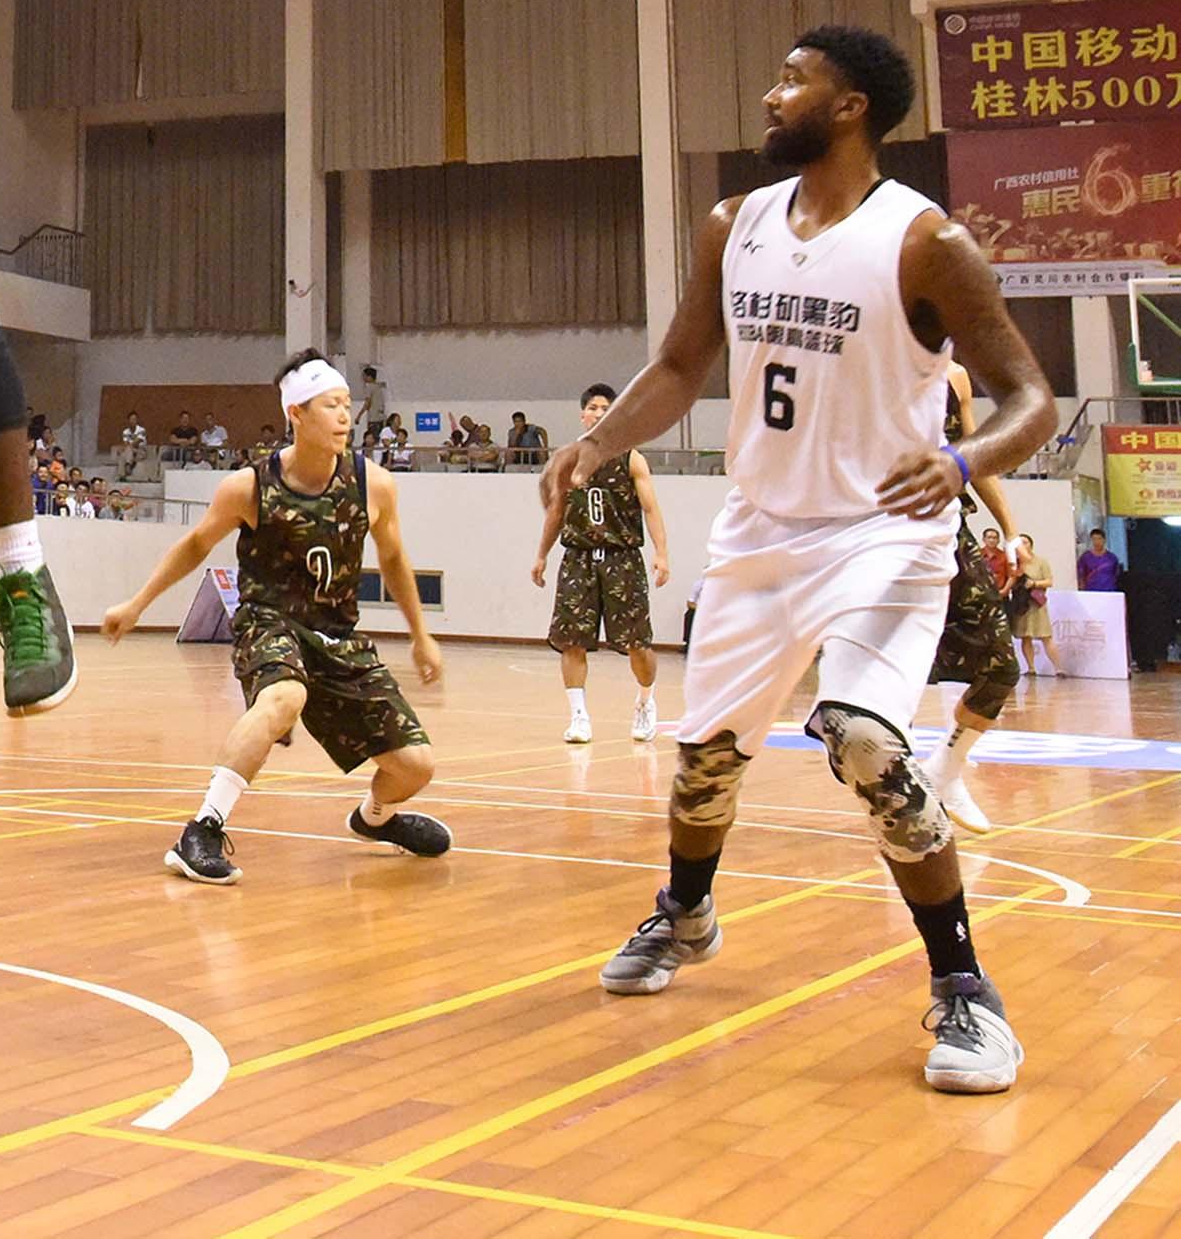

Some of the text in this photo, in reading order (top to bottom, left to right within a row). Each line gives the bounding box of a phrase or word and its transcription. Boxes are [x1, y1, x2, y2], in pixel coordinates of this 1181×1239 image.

[971, 24, 1177, 73] 中国移动
[763, 361, 796, 431] 6
